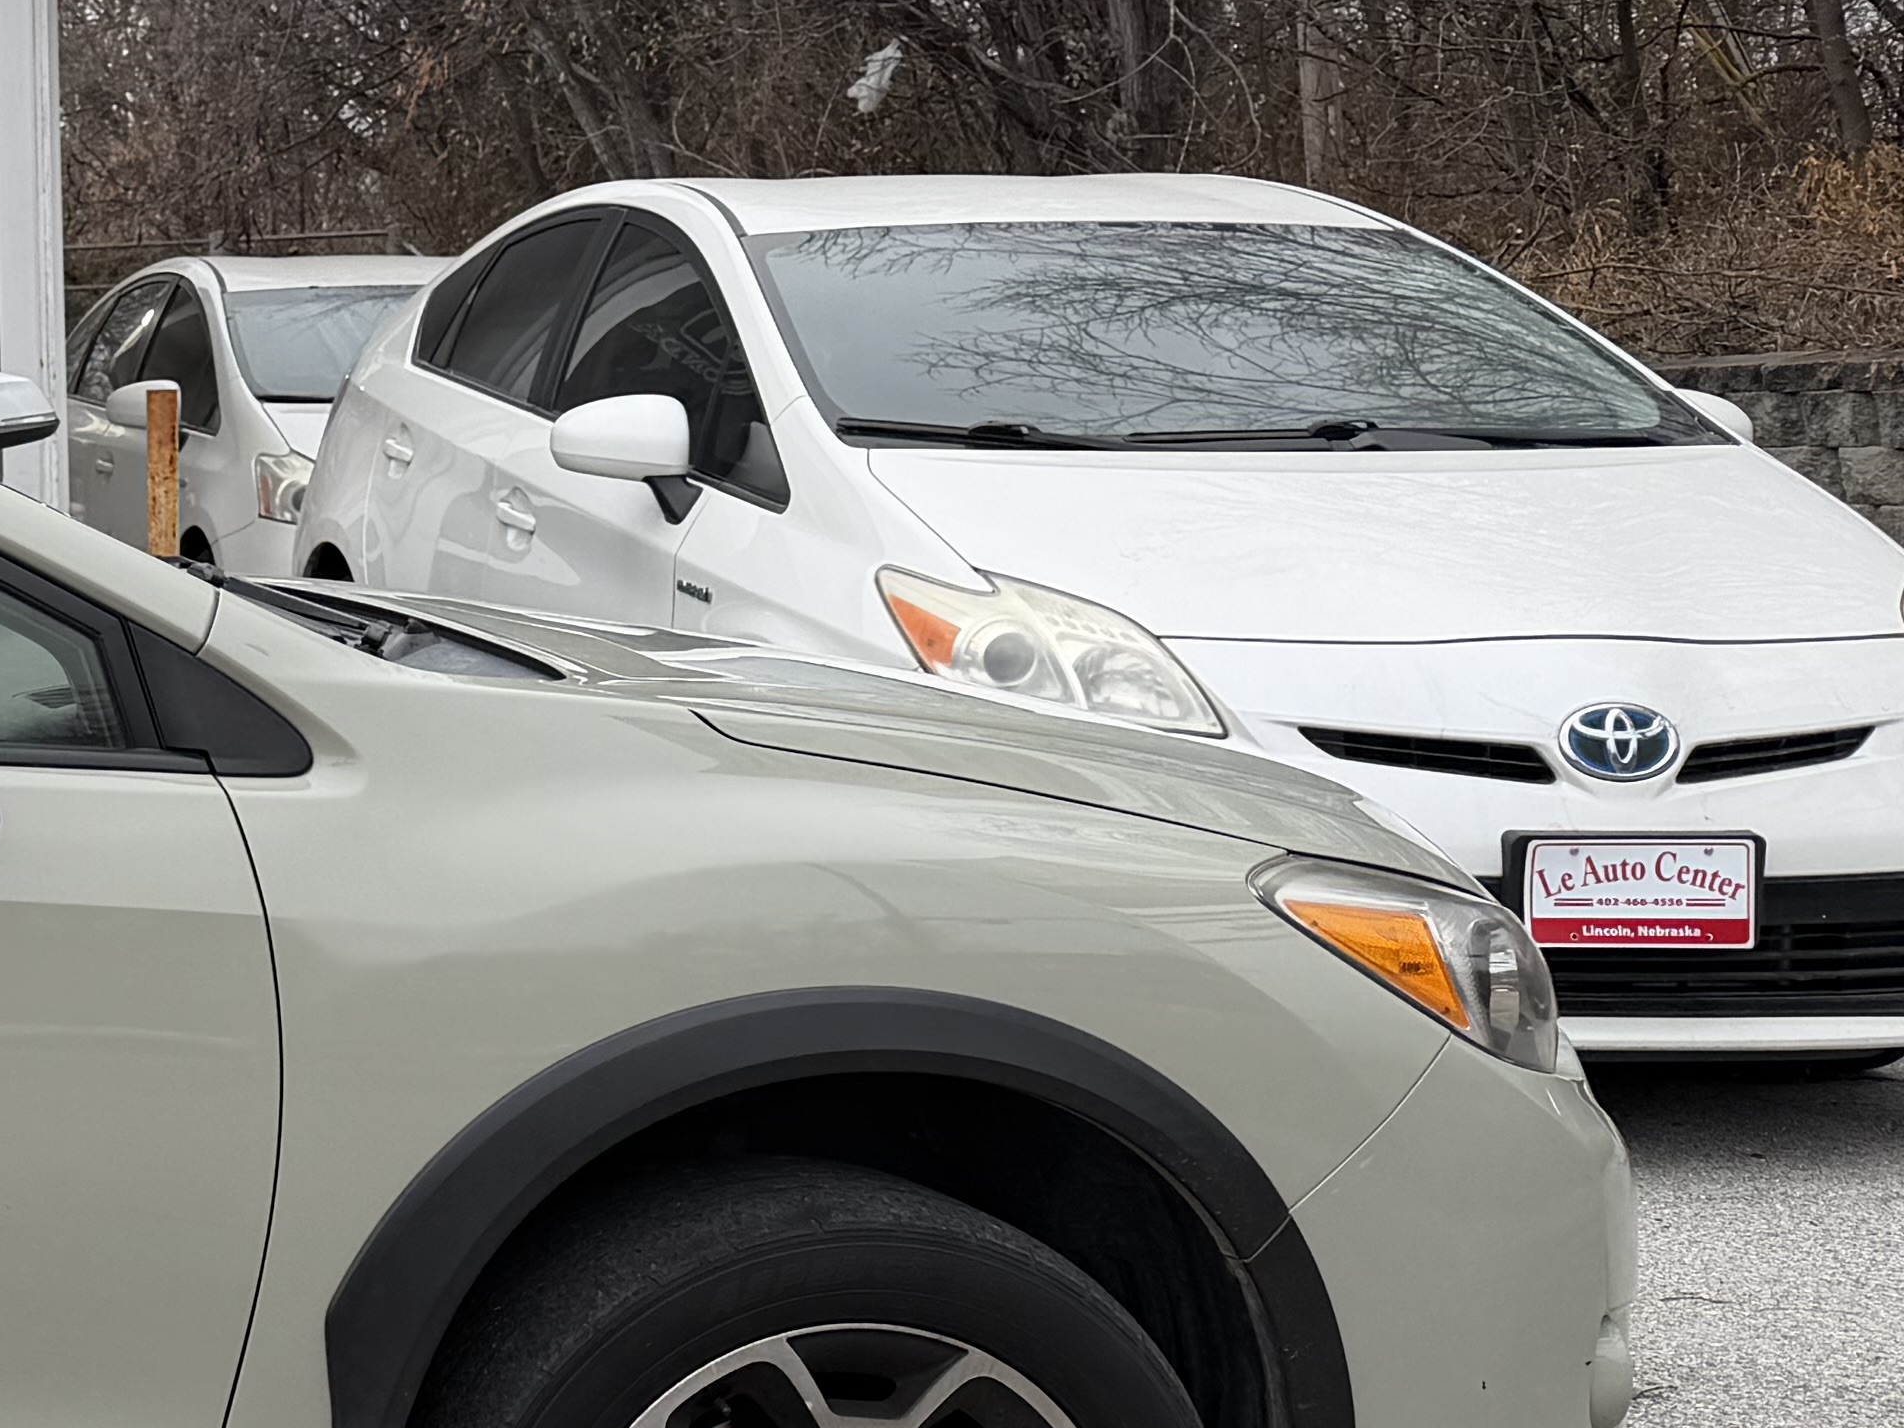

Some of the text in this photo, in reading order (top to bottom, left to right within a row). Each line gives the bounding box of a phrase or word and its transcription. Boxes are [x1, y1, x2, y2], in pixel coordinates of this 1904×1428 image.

[1536, 851, 1745, 901] Le Auto Center
[1582, 925, 1702, 938] Lincoln, Nebraska
